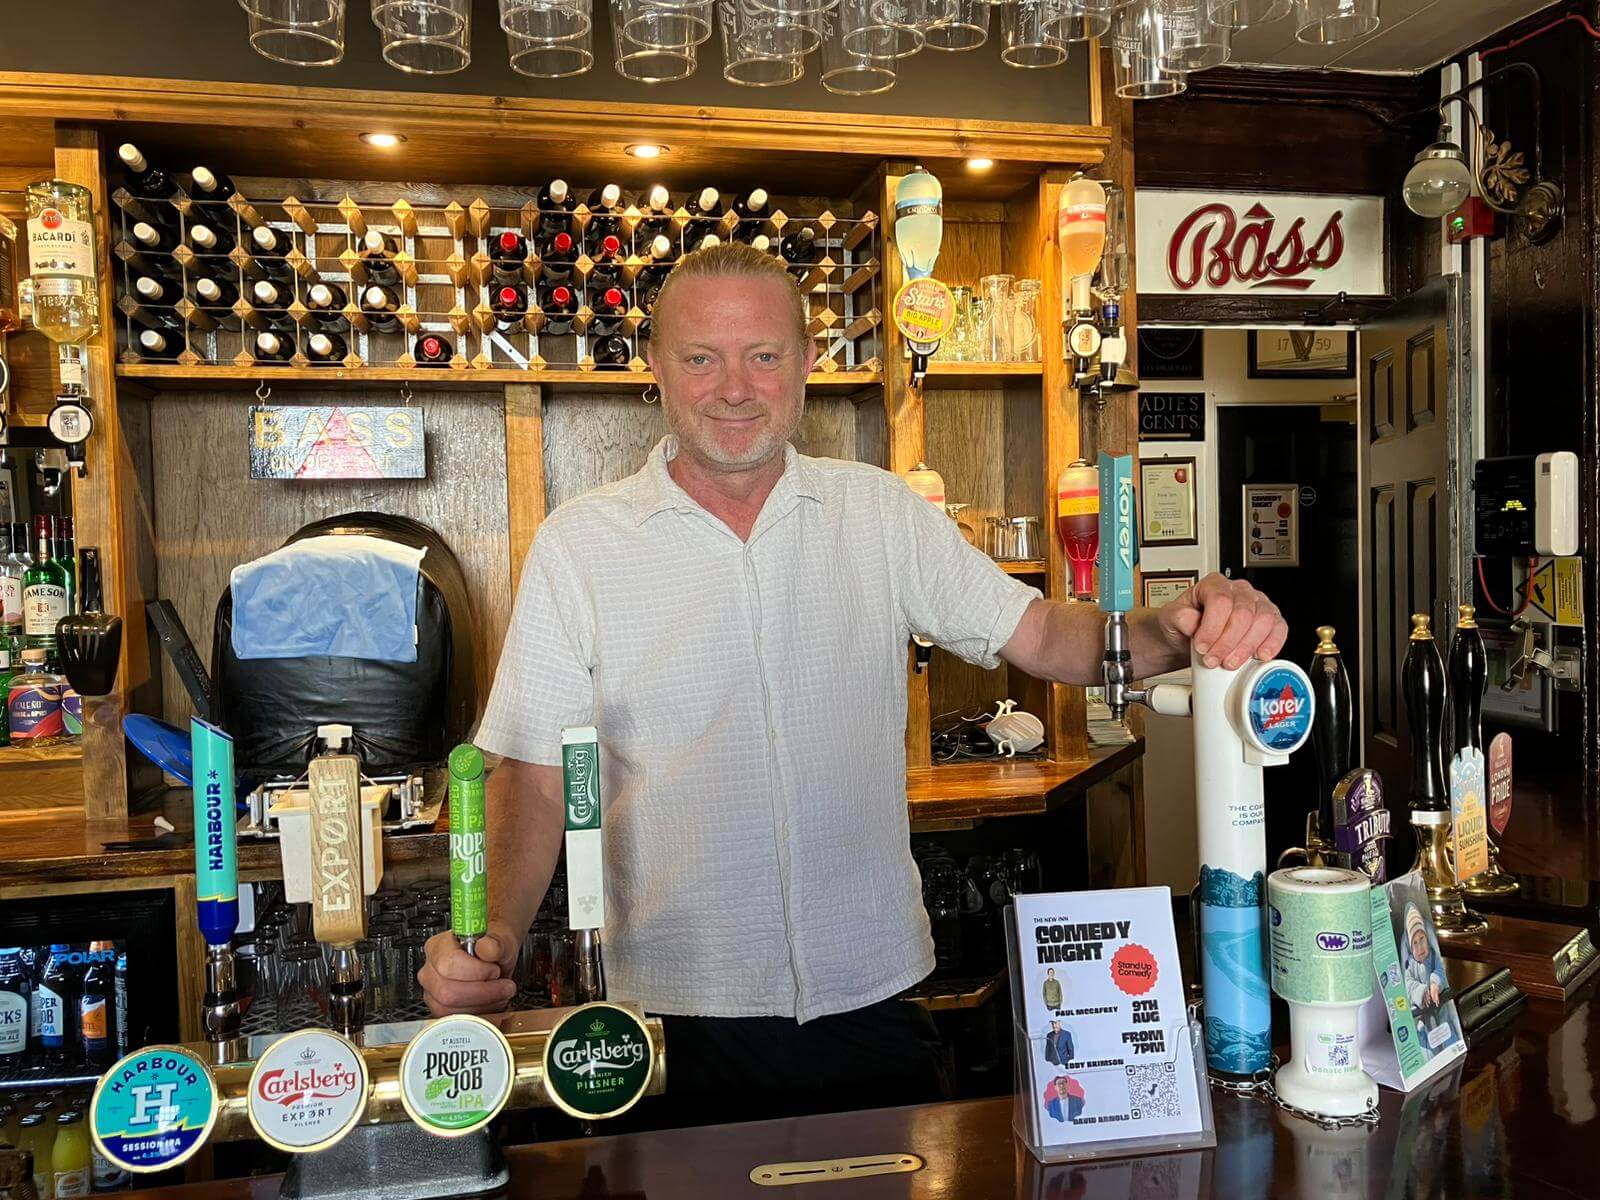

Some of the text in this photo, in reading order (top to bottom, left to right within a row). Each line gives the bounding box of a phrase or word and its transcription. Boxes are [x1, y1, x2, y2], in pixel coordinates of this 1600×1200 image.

[1167, 202, 1344, 289] Bass
[1315, 337, 1332, 351] 59
[1140, 396, 1199, 412] ADIES
[255, 411, 414, 449] BASS
[1142, 414, 1199, 430] GENTS
[1119, 476, 1131, 569] korev
[24, 587, 66, 600] JAMESON
[1260, 697, 1305, 717] korev
[1269, 720, 1297, 730] LAGER
[1491, 767, 1511, 784] LONDON
[568, 749, 596, 825] Carlsberg
[1491, 778, 1511, 805] PRIDE
[206, 782, 224, 871] HARBOUR
[1457, 815, 1483, 839] LIQUID
[1458, 831, 1485, 850] SUNSHINE
[461, 850, 486, 883] JO
[454, 888, 462, 934] HOPPED
[1035, 920, 1131, 944] COMEDY
[55, 949, 116, 967] POLAR
[1036, 942, 1104, 964] NIGHT
[1117, 961, 1152, 971] Stand Up
[1118, 968, 1152, 979] Comedy
[1055, 1009, 1075, 1017] PAUL
[1132, 1000, 1158, 1012] 9TH
[1132, 1010, 1161, 1024] AUG
[1122, 1029, 1164, 1043] FROM
[553, 1036, 644, 1076] Carlsberg
[1132, 1041, 1166, 1054] 7PM
[423, 1048, 490, 1080] PROPER
[111, 1057, 198, 1094] HARBOUR
[446, 1067, 482, 1099] JOB
[576, 1077, 625, 1090] PILSNER
[258, 1064, 356, 1107] Carlsberg
[460, 1093, 484, 1110] IPA
[122, 1140, 162, 1152] SESSION
